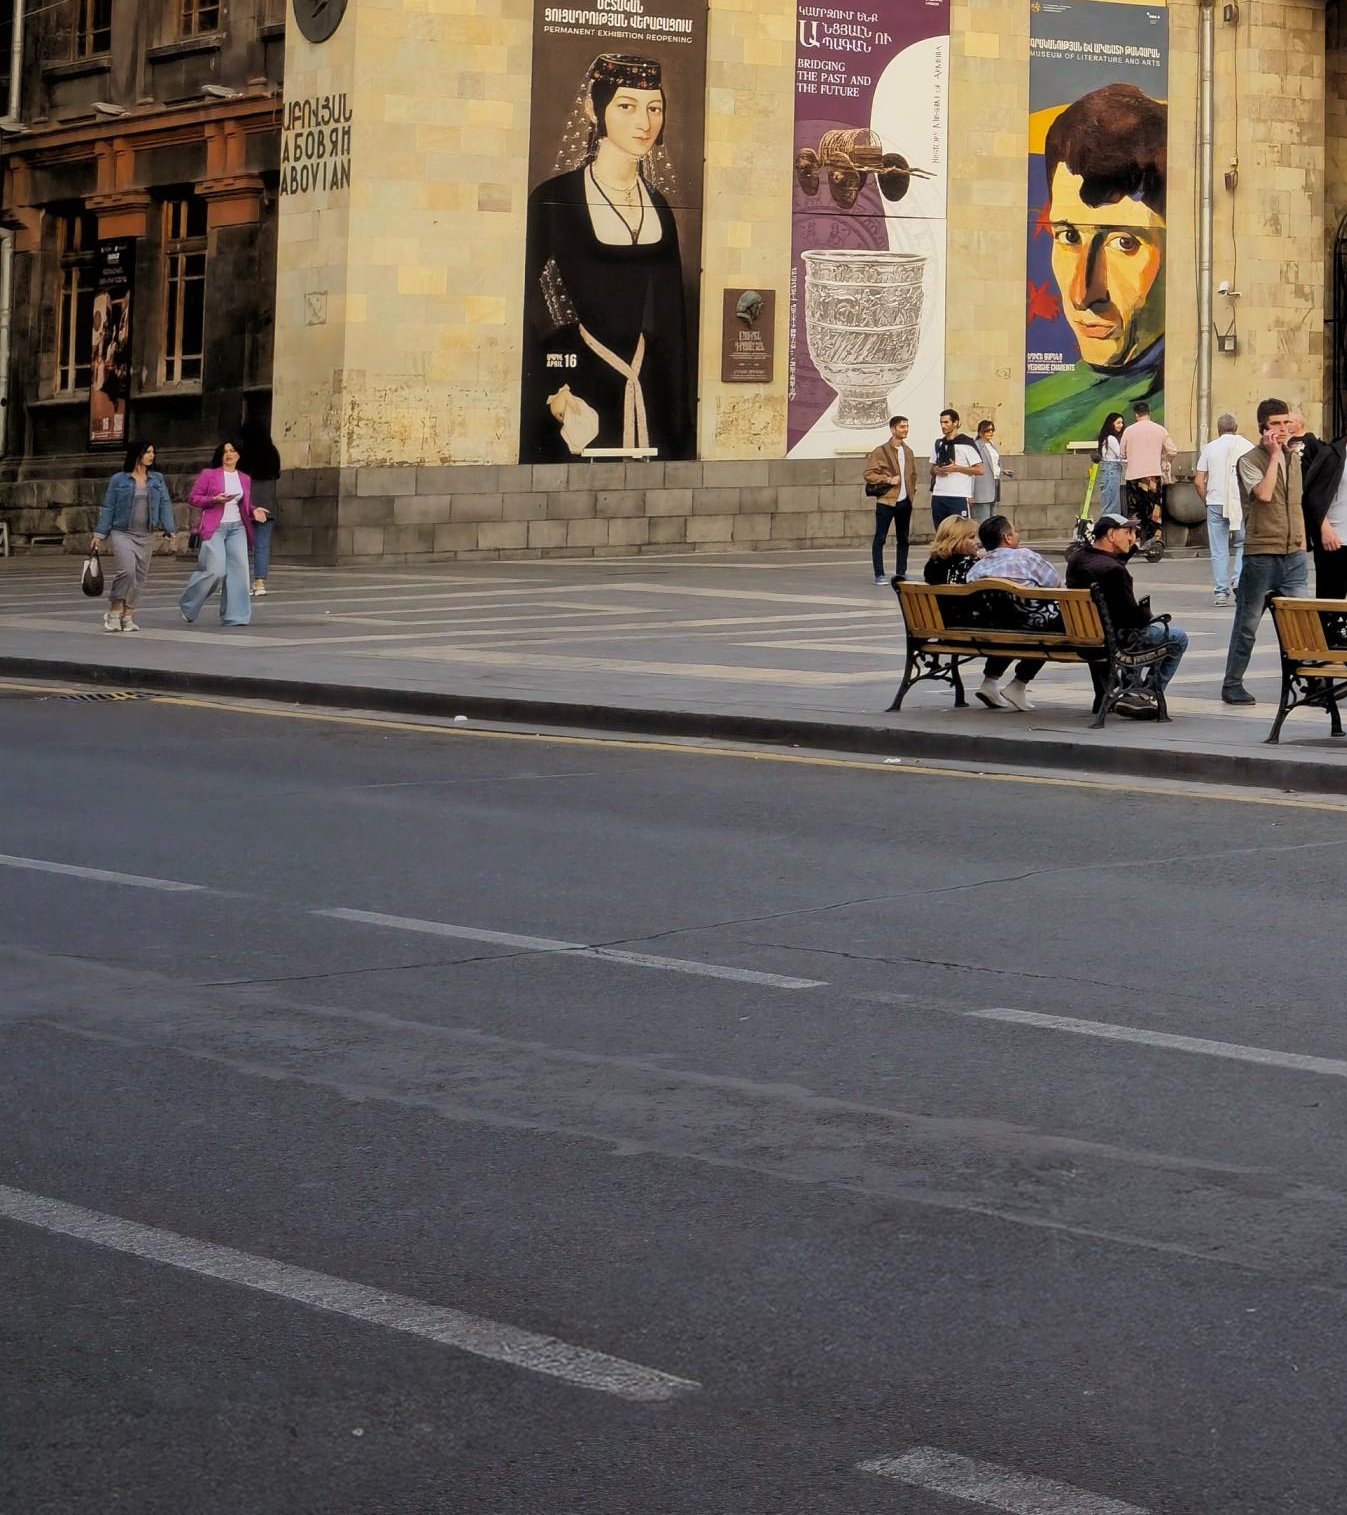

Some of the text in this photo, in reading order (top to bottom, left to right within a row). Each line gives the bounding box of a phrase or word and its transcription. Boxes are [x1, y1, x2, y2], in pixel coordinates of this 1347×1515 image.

[799, 6, 855, 21] ԿԱՄՐՋՈՒՄ
[544, 25, 693, 44] PERMANENT EXHIBITION REOPENING
[797, 58, 846, 72] BRIDGING
[1030, 50, 1160, 67] MUSEUM OF LITERATURE AND ARTS
[797, 71, 871, 86] THE PAST AND
[796, 83, 859, 97] THE FUTURE
[283, 93, 352, 131] ԱԲՈՎՅԱՆ
[282, 125, 351, 163] АБОВЯН
[280, 158, 351, 196] ABOVIAN
[564, 354, 577, 368] 16
